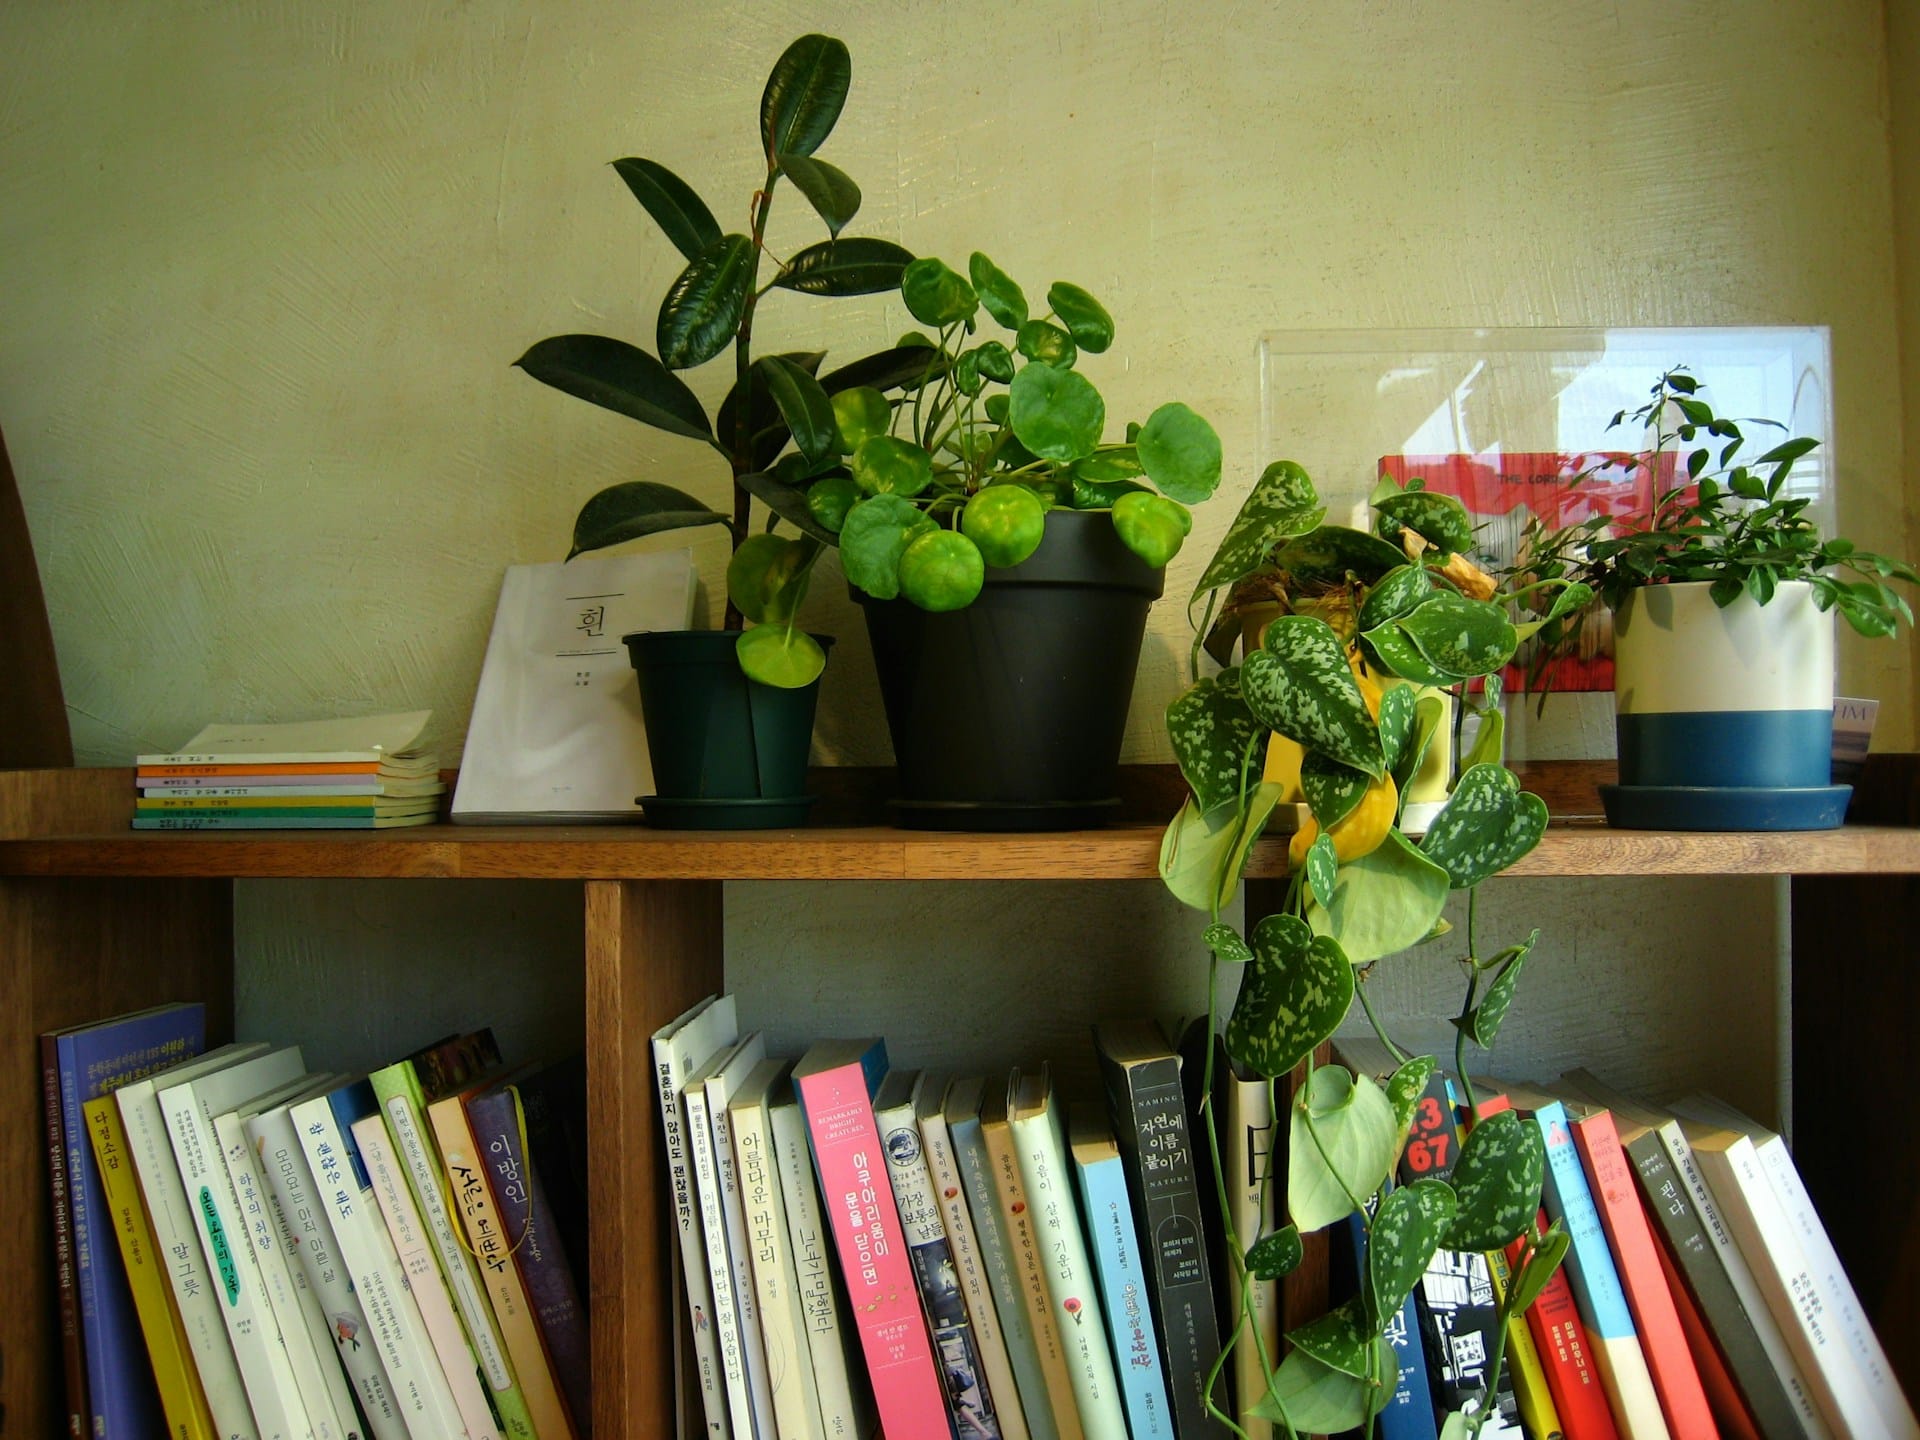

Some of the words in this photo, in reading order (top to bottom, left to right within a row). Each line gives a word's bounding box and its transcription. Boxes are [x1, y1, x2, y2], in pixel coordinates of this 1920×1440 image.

[576, 606, 604, 637] 흰
[658, 1061, 676, 1115] 결혼하지
[1137, 1093, 1178, 1107] NAMING
[307, 1119, 325, 1137] 참
[816, 1106, 864, 1124] REMARKABLY
[828, 1117, 856, 1130] BRIGHT
[1138, 1109, 1183, 1137] 자연에
[93, 1110, 122, 1171] 다정소감
[666, 1120, 683, 1159] 않아도
[824, 1124, 865, 1140] CREATURES
[1148, 1132, 1179, 1152] 이름
[313, 1140, 343, 1186] 괜찮은
[933, 1139, 947, 1167] 곰돌이
[965, 1146, 981, 1171] 내가
[1143, 1147, 1188, 1174] 붙이기
[1407, 1134, 1449, 1172] 67
[487, 1131, 529, 1207] 이방인
[739, 1131, 771, 1205] 아름다운
[999, 1153, 1015, 1182] 곰돌이
[972, 1170, 990, 1203] 죽으면
[1149, 1175, 1189, 1188] NATURE
[1670, 1136, 1686, 1156] 우리
[1702, 1203, 1731, 1246] 진지합니다
[332, 1188, 356, 1219] 태도
[673, 1164, 692, 1231] 괜찮을까?
[702, 1191, 719, 1227] 이병률
[848, 1151, 893, 1257] 아쿠아리움이
[897, 1190, 925, 1212] 가장
[237, 1171, 263, 1217] 하루의
[252, 1218, 275, 1252] 취향
[273, 1148, 306, 1204] 모모요는
[296, 1205, 318, 1235] 아직
[308, 1236, 330, 1265] 아흔
[320, 1267, 337, 1284] 살
[451, 1160, 488, 1217] 서른은
[470, 1215, 509, 1277] 예쁘다
[902, 1204, 939, 1227] 보통의
[950, 1203, 964, 1232] 행복한
[1030, 1149, 1053, 1194] 마음이
[1043, 1201, 1061, 1232] 살짝
[1052, 1239, 1075, 1283] 기운다
[752, 1209, 778, 1265] 마무리
[843, 1191, 864, 1228] 문을
[854, 1232, 878, 1286] 닫으면
[916, 1220, 944, 1240] 날들
[980, 1204, 1002, 1248] 장례식에
[1015, 1218, 1032, 1249] 행복한
[201, 1189, 215, 1218] 모든
[208, 1219, 228, 1261] 요일의
[221, 1263, 238, 1295] 기록
[708, 1230, 723, 1255] 시집
[797, 1226, 825, 1280] 그녀가
[958, 1233, 969, 1253] 일은
[1110, 1211, 1120, 1224] 아빠
[1117, 1245, 1128, 1270] 그림일기
[1161, 1238, 1180, 1247] 보이지
[169, 1239, 204, 1299] 말그릇
[965, 1255, 976, 1275] 매일
[1023, 1250, 1037, 1271] 일은
[1172, 1268, 1191, 1279] 시작할
[1178, 1258, 1196, 1267] 보이기
[360, 1274, 375, 1295] 수많은
[371, 1269, 383, 1285] 15년
[711, 1266, 732, 1307] 바다는
[765, 1278, 778, 1299] 법정
[968, 1276, 981, 1297] 있어
[1029, 1272, 1042, 1294] 매일
[376, 1284, 389, 1300] 동안
[1033, 1295, 1047, 1316] 있어
[1117, 1282, 1146, 1329] 아빠는
[367, 1295, 386, 1327] 사람들에게
[385, 1307, 399, 1327] 위에서
[718, 1310, 732, 1324] 잘
[804, 1280, 835, 1336] 말했다
[392, 1326, 405, 1342] 만난
[1127, 1327, 1148, 1354] 여섯
[721, 1330, 743, 1383] 있습니다
[1077, 1336, 1090, 1360] 나태주
[1130, 1352, 1153, 1371] 살
[1557, 1346, 1569, 1362] 옮김
[1563, 1320, 1575, 1340] 미셸
[1570, 1341, 1585, 1367] 자우너
[1579, 1369, 1590, 1384] 지음
[700, 1356, 711, 1376] 마스다
[1083, 1363, 1095, 1380] 신작
[704, 1376, 714, 1392] 미리
[1089, 1382, 1100, 1401] 시집
[1141, 1390, 1156, 1411] 유영근
